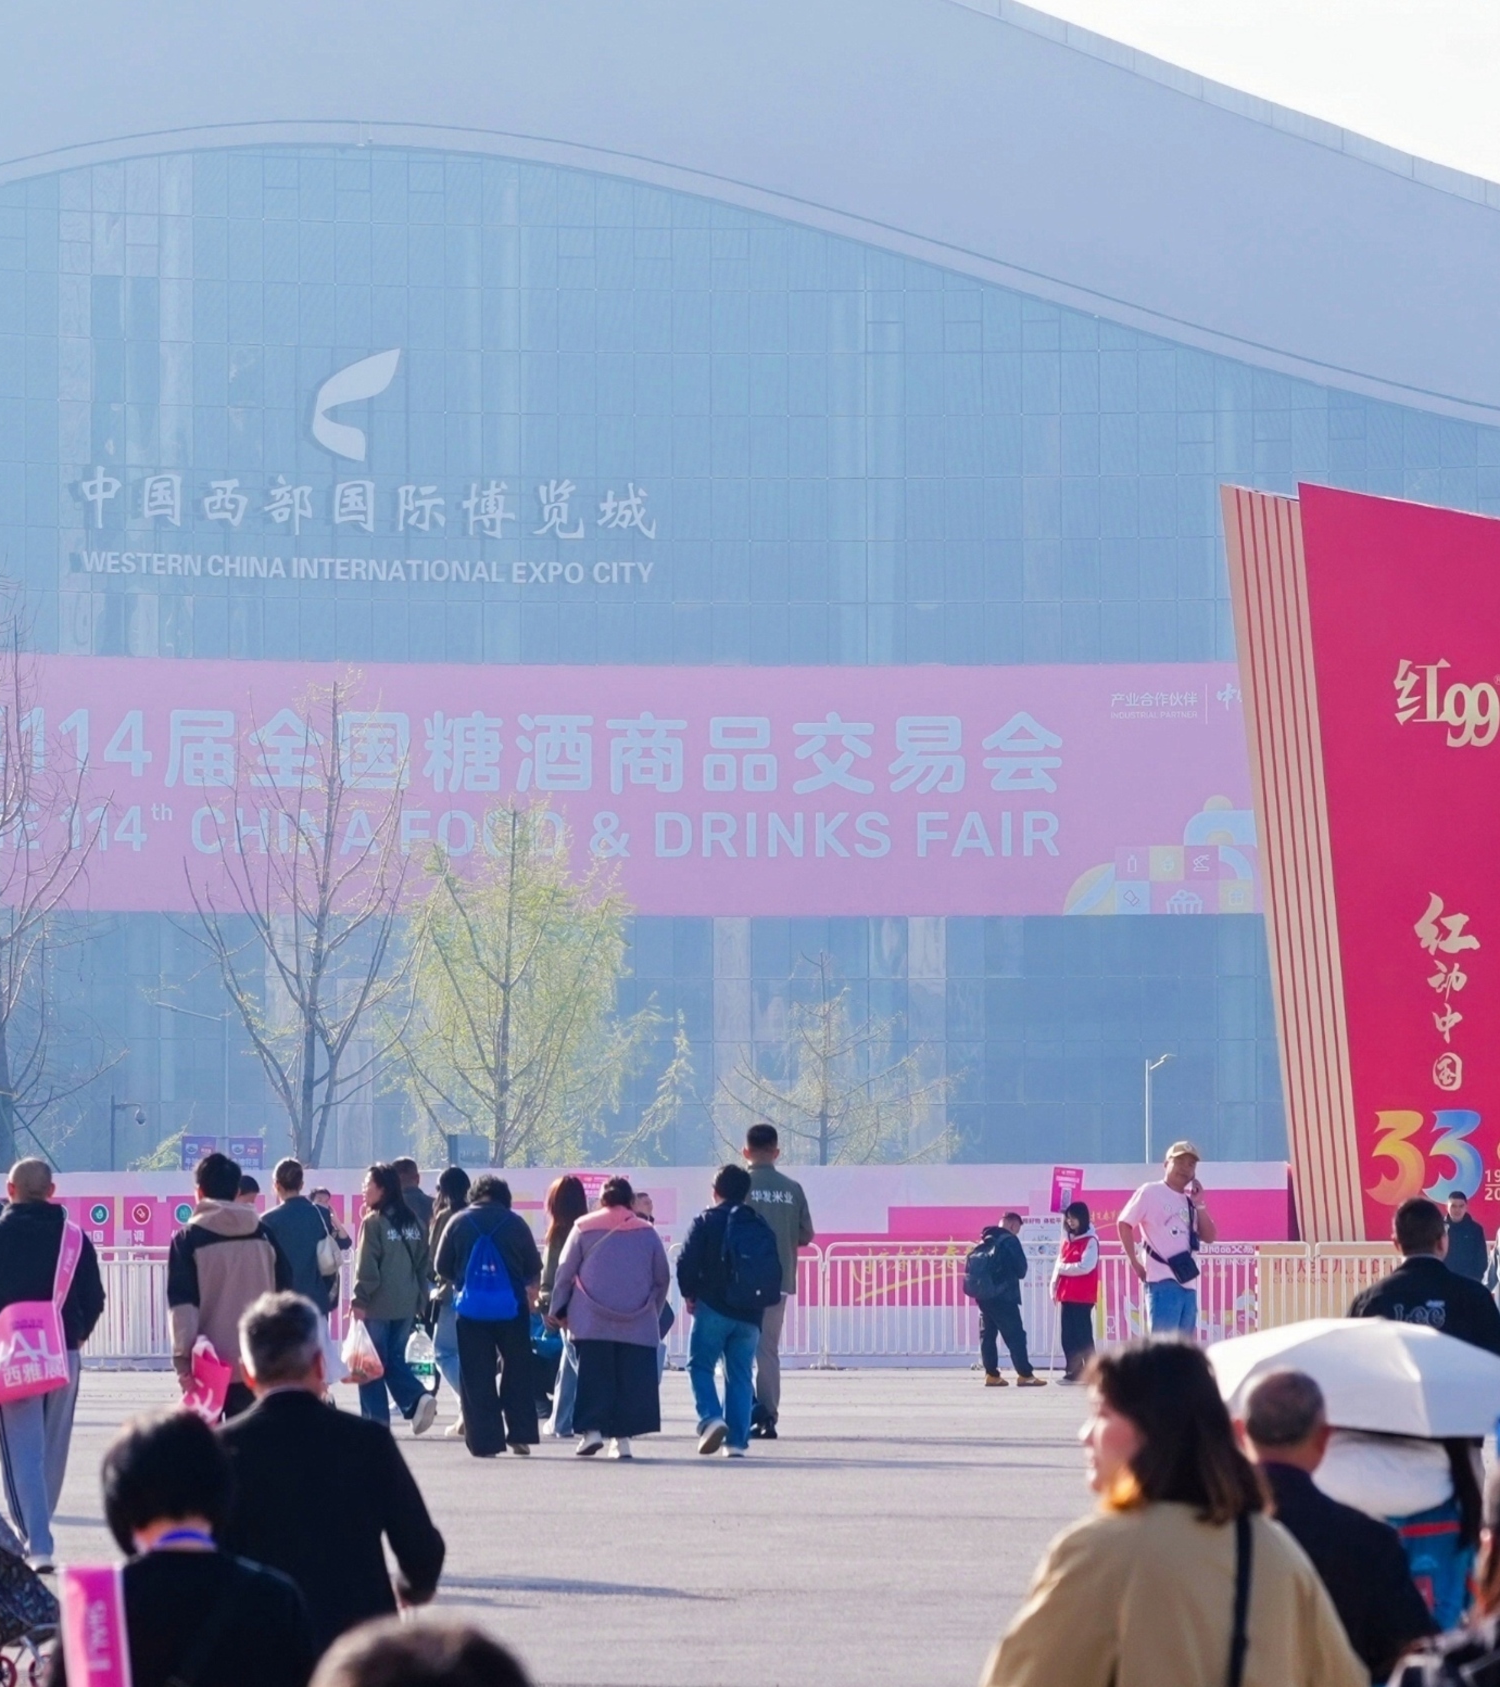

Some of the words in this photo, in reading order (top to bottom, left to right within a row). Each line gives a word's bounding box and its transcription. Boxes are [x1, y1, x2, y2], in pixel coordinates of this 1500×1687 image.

[80, 465, 657, 539] 中国西部国际博览城
[81, 550, 201, 577] WESTERN
[207, 554, 286, 579] CHINA
[292, 557, 505, 583] INTERNATIONAL
[512, 561, 584, 585] EXPO
[592, 561, 655, 585] CITY
[1110, 692, 1198, 707] 产业合作伙伴
[1111, 711, 1157, 719] INDUSTRIAL
[1160, 711, 1198, 719] PARTNER
[191, 805, 382, 855] CHINA
[401, 810, 565, 858] FOOD
[589, 812, 631, 858] &
[654, 811, 891, 858] DRINKS
[917, 811, 1060, 858] FAIR
[1414, 891, 1481, 1091] 红动中国
[1365, 1108, 1483, 1207] 33
[387, 1227, 421, 1242] 华米业
